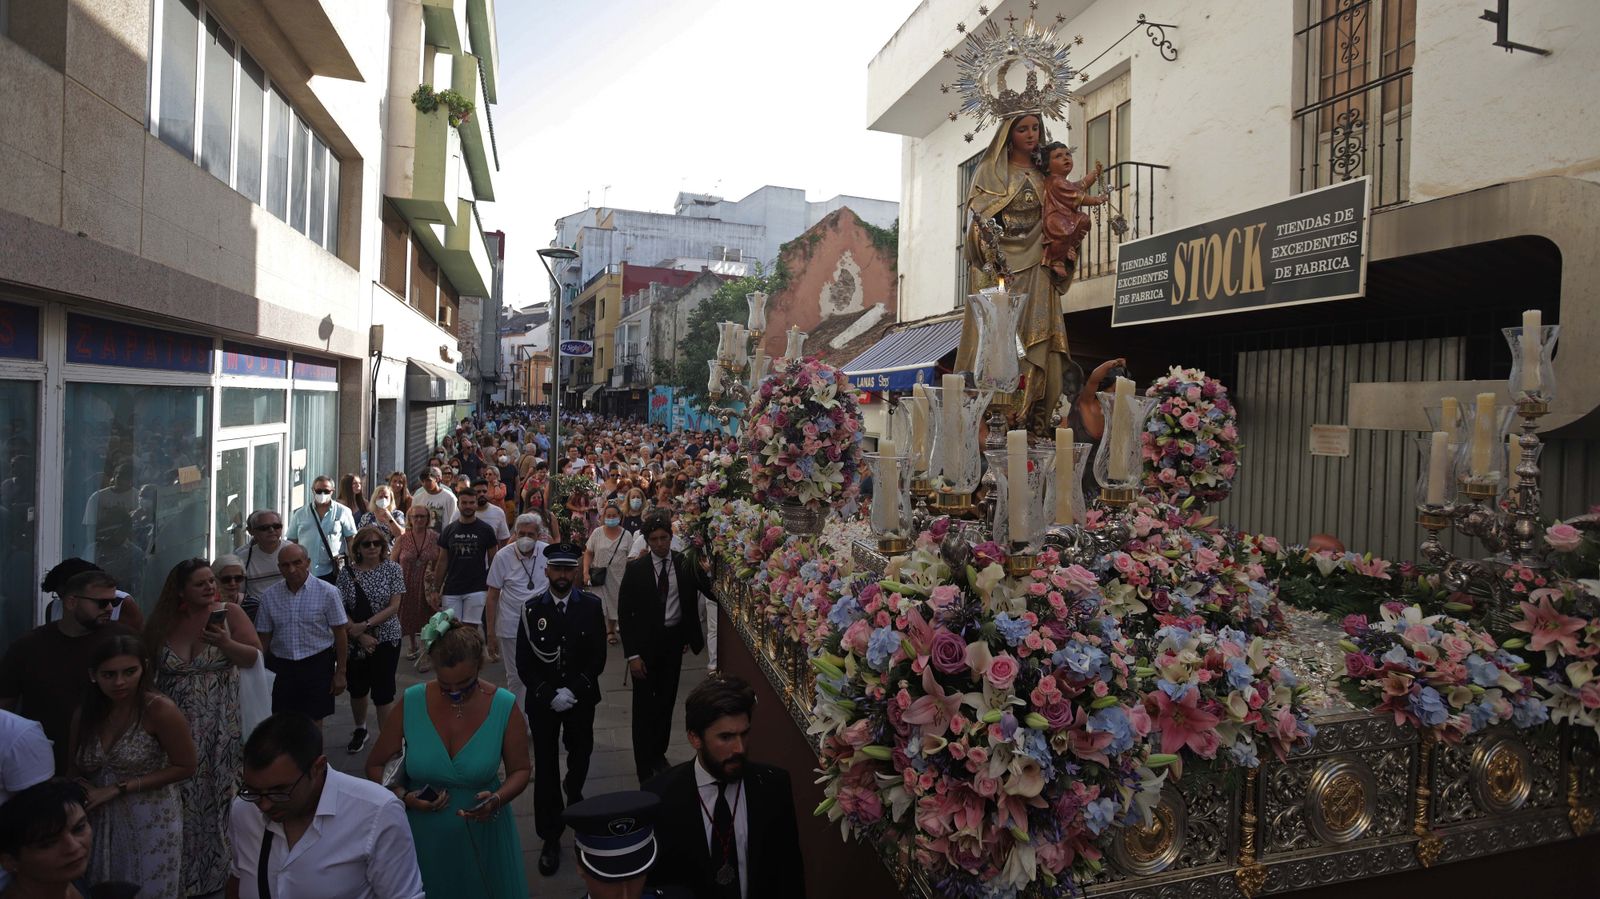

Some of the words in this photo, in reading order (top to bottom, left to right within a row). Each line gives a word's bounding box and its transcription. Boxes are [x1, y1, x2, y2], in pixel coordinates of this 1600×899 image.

[1276, 213, 1332, 237] TIENDAS
[1334, 207, 1355, 224] DE
[1271, 230, 1358, 259] EXCEDENTES
[1121, 255, 1154, 272] TIENDAS
[1155, 252, 1168, 263] DE
[1171, 222, 1266, 305] STOCK
[1274, 267, 1293, 280] DE
[1294, 256, 1350, 276] FABRICA
[1118, 269, 1169, 289] EXCEDENTES
[1119, 294, 1131, 305] DE
[1131, 288, 1164, 304] FABRICA
[74, 322, 206, 367] ZAPATOS
[227, 348, 281, 374] MODA
[856, 376, 875, 388] LANAS
